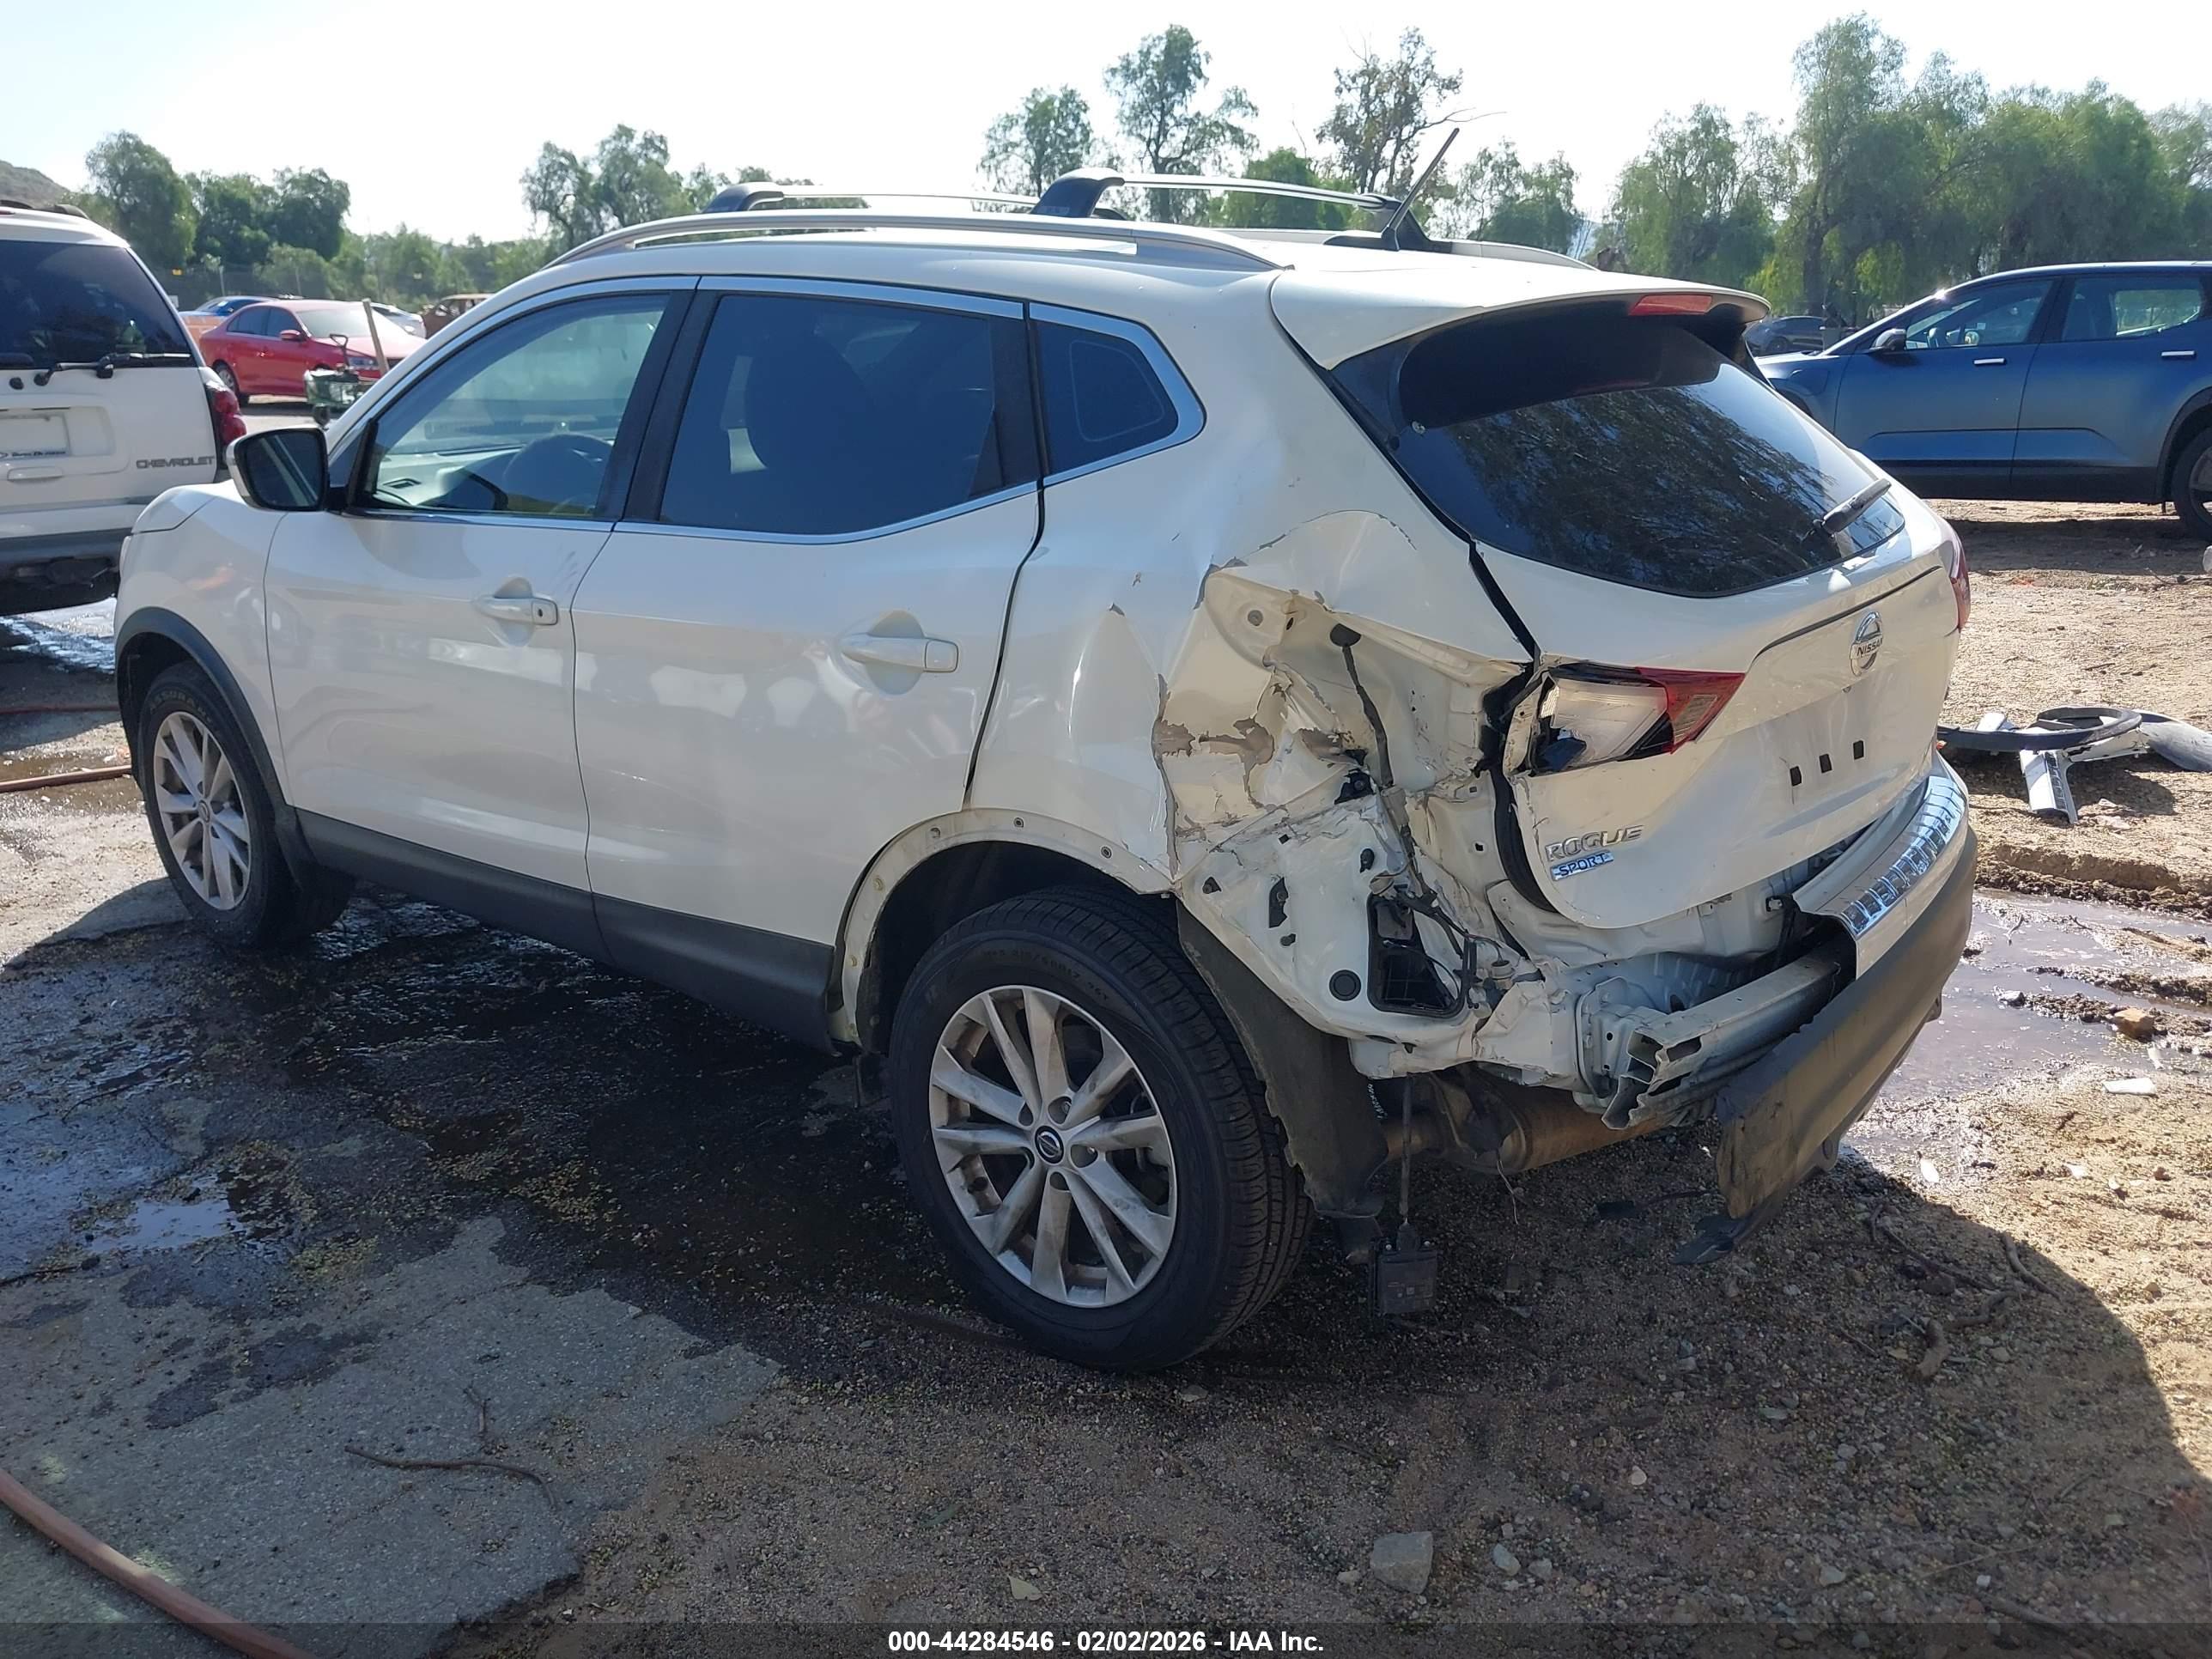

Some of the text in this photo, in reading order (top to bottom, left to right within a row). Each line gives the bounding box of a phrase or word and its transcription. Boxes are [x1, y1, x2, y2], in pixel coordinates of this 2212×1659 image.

[136, 456, 215, 469] CHEVROLET
[1545, 824, 1644, 862] ROGUE
[1559, 853, 1607, 876] SPORT
